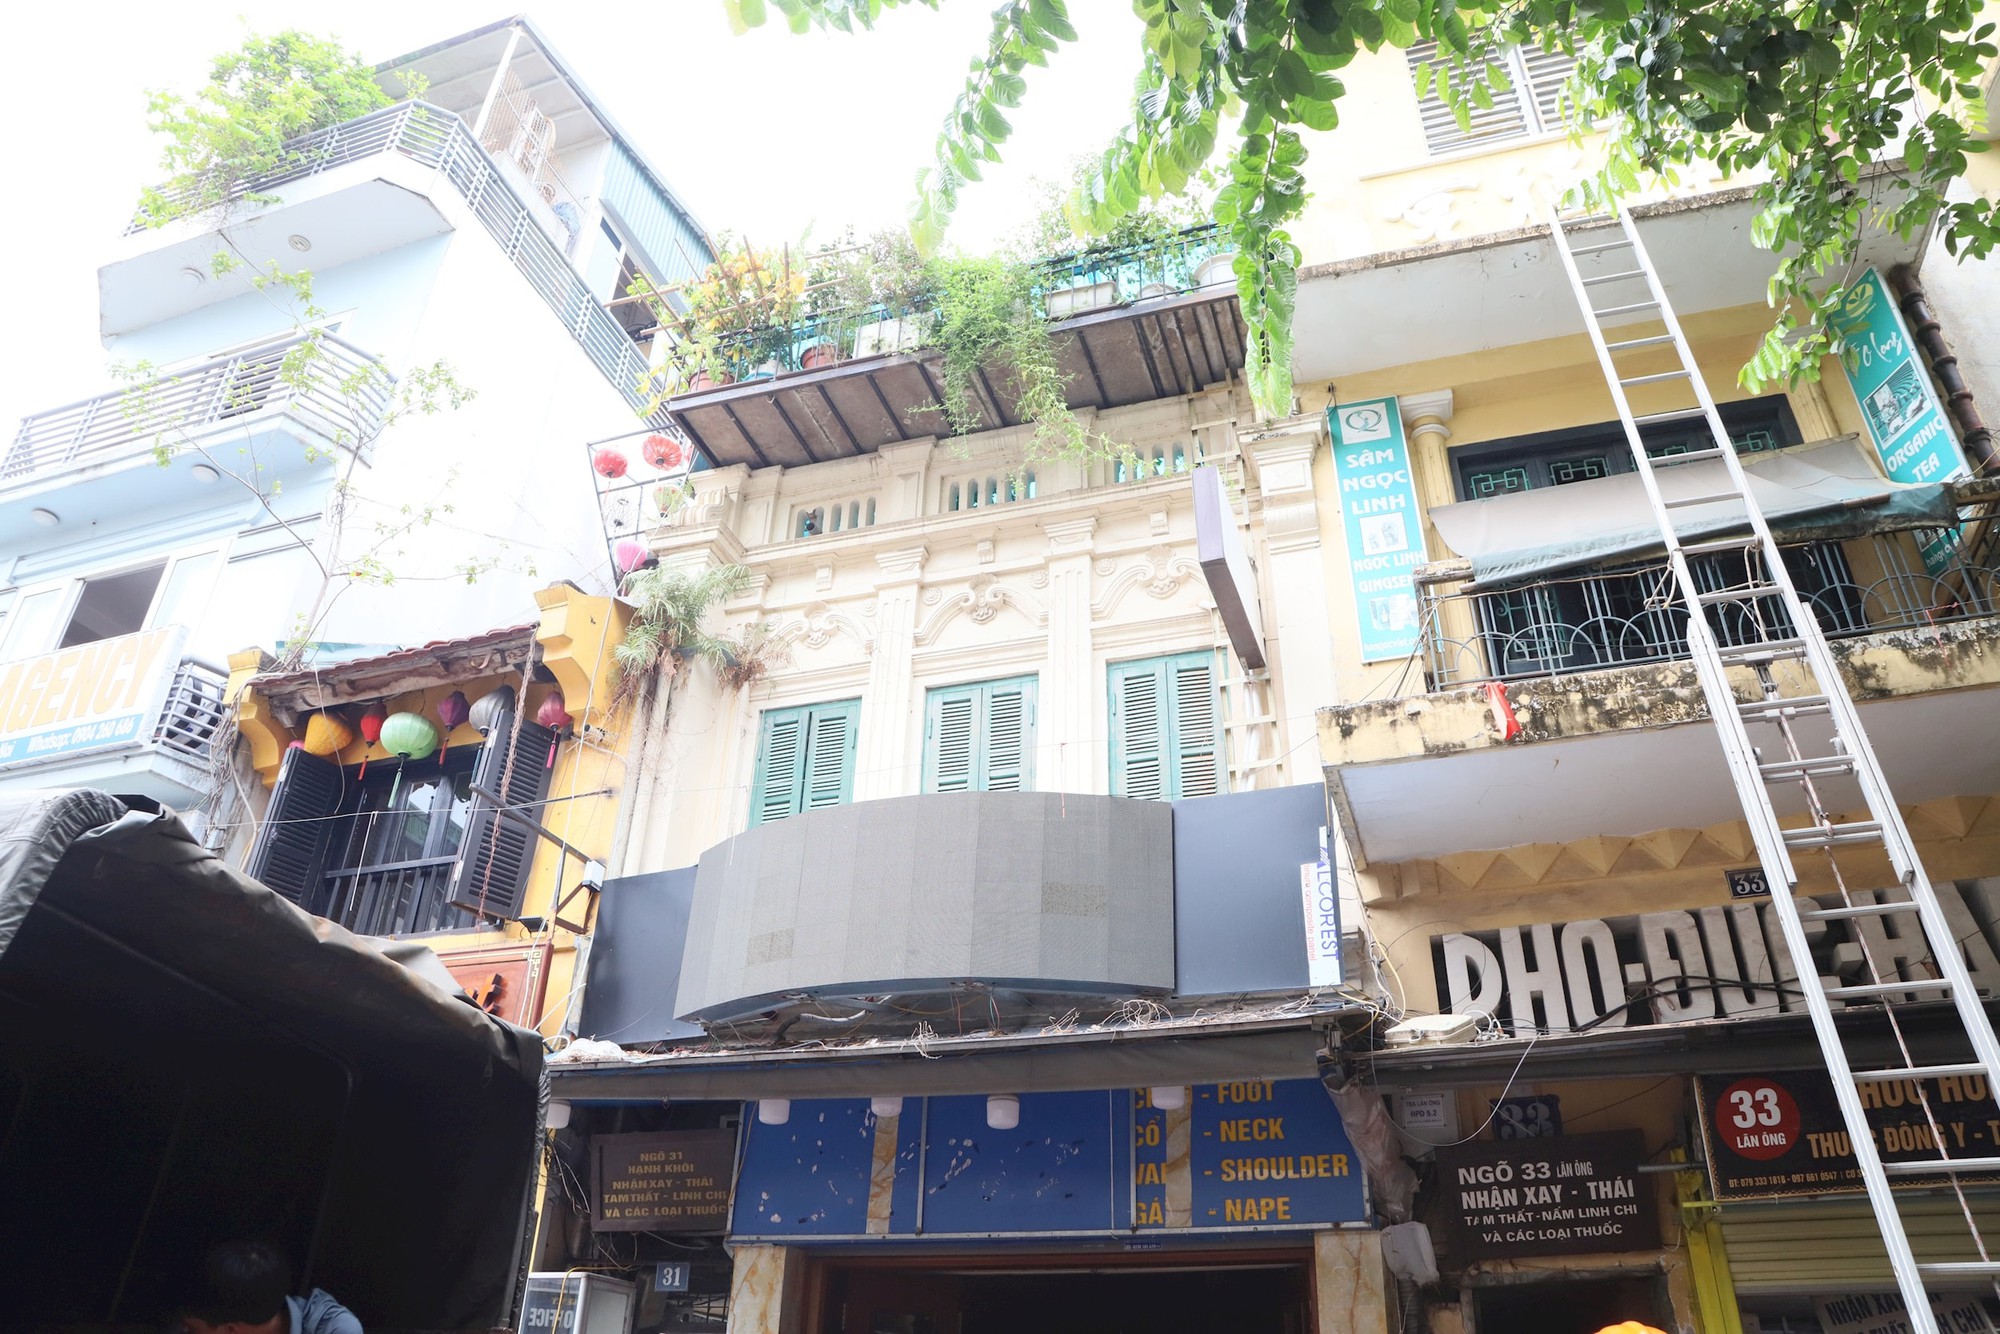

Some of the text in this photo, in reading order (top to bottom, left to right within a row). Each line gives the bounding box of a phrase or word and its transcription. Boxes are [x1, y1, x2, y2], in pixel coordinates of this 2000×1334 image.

[1886, 415, 1944, 473] ORGANIC
[1345, 448, 1395, 469] SÂM
[1911, 451, 1940, 482] TEA
[1342, 469, 1408, 493] NGỌC
[1350, 493, 1407, 516] LINH
[1353, 549, 1426, 573] NGOC LINH
[0, 630, 168, 733] AGENCY
[1736, 874, 1766, 894] 33
[1218, 1081, 1274, 1104] FOOT
[1730, 1087, 1782, 1129] 33
[1220, 1117, 1285, 1142] NECK
[1736, 1131, 1787, 1150] LÃN ÔNG
[1950, 1121, 1965, 1148] Y
[668, 1151, 683, 1161] 31
[1220, 1153, 1349, 1182] SHOULDER
[628, 1164, 662, 1176] HẠNH
[1457, 1159, 1594, 1186] NGÕ 33 LÃN ÔNG
[1755, 1176, 1768, 1186] 333
[1769, 1174, 1786, 1185] 1818
[612, 1177, 647, 1191] NHẬN
[648, 1178, 673, 1190] XAY
[1460, 1185, 1519, 1211] NHẬN
[1523, 1184, 1563, 1206] XAY
[1586, 1175, 1636, 1201] THÁI
[603, 1193, 629, 1204] TAM
[630, 1189, 661, 1202] THẤT
[672, 1191, 702, 1201] LINH
[604, 1203, 728, 1218] VÀ CÁC LOẠI THUỐC
[1224, 1196, 1292, 1222] NAPE
[1578, 1206, 1611, 1219] LINH
[1613, 1203, 1638, 1216] CHI
[1482, 1220, 1623, 1244] VÀ CÁC LOẠI THUỐC
[662, 1266, 681, 1287] 31
